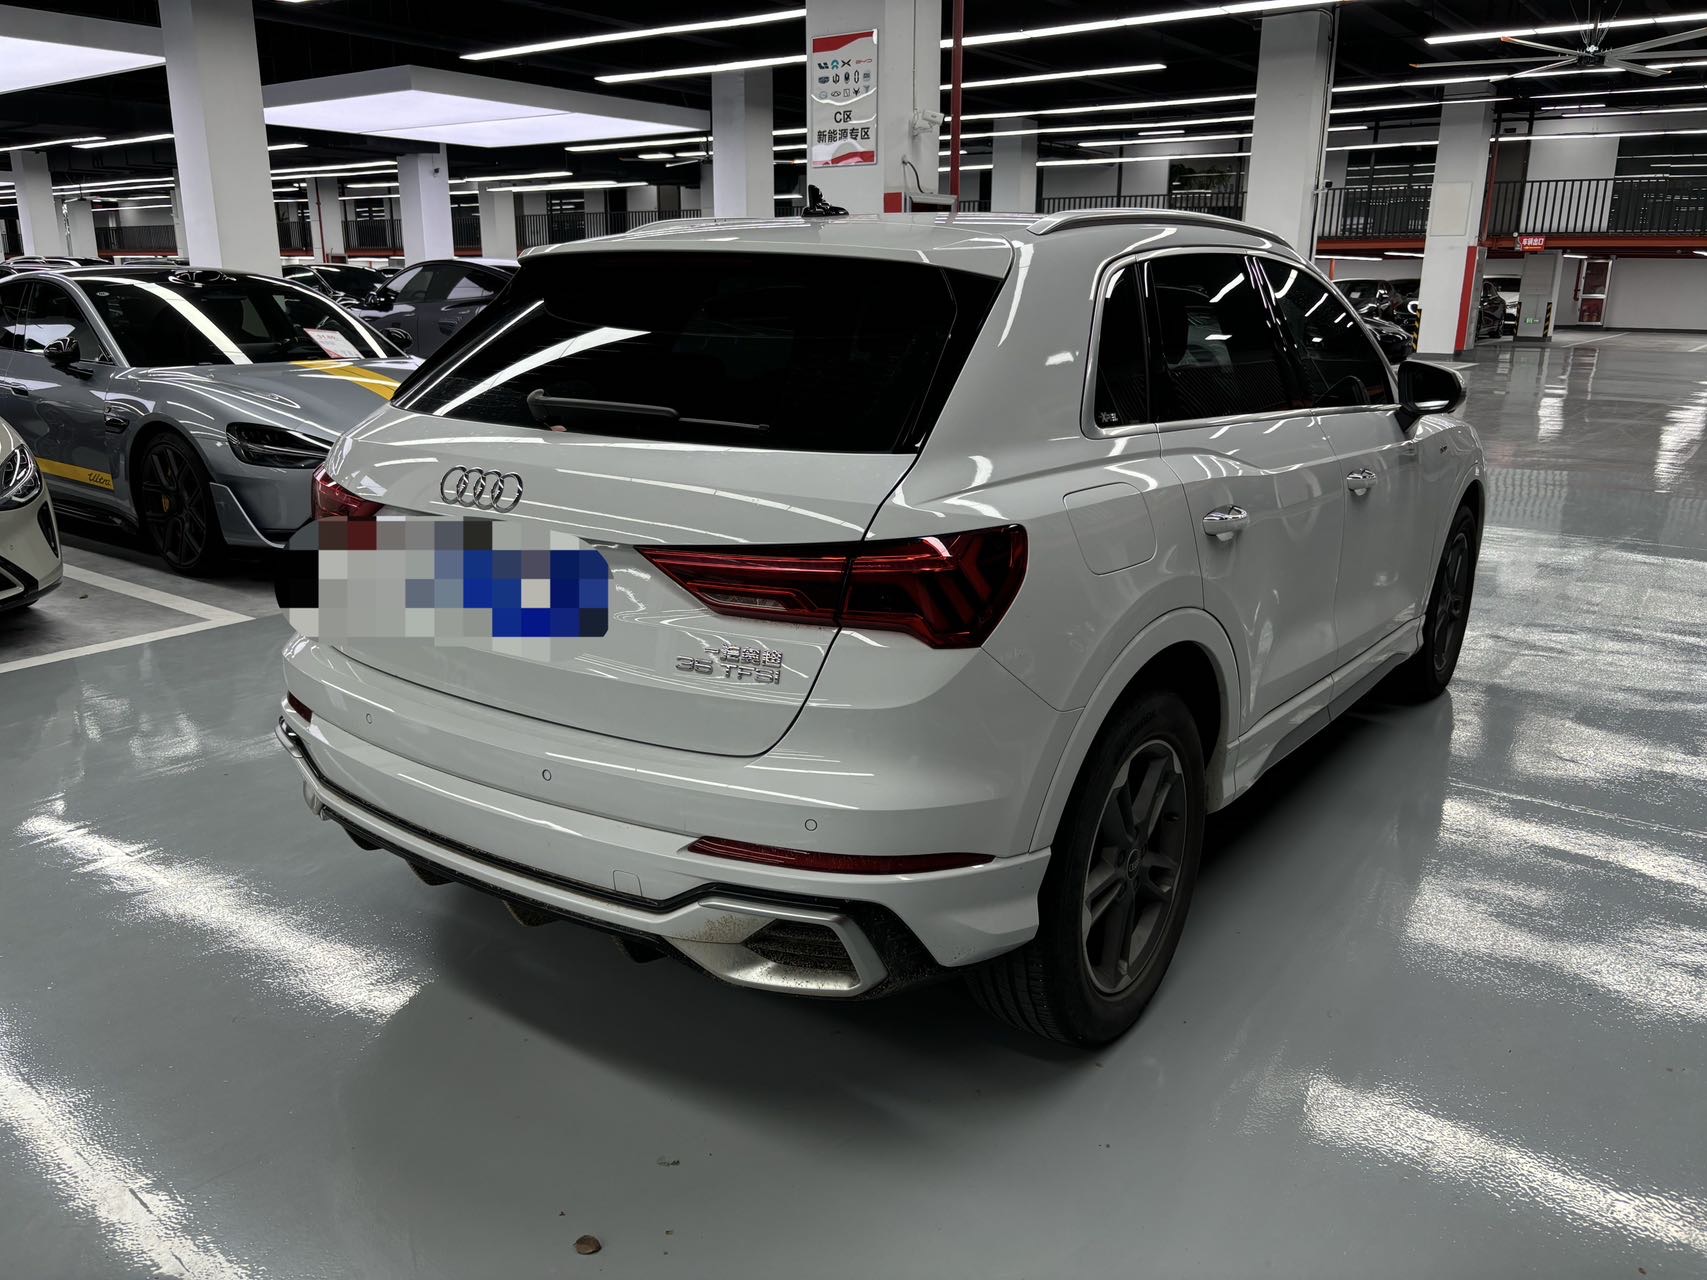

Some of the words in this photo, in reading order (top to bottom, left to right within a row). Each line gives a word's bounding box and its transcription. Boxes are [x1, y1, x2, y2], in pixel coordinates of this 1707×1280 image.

[834, 110, 852, 123] C区
[817, 127, 871, 143] 新能源专区
[87, 471, 112, 487] Ultra
[675, 655, 714, 675] 35
[719, 662, 781, 684] TFSI
